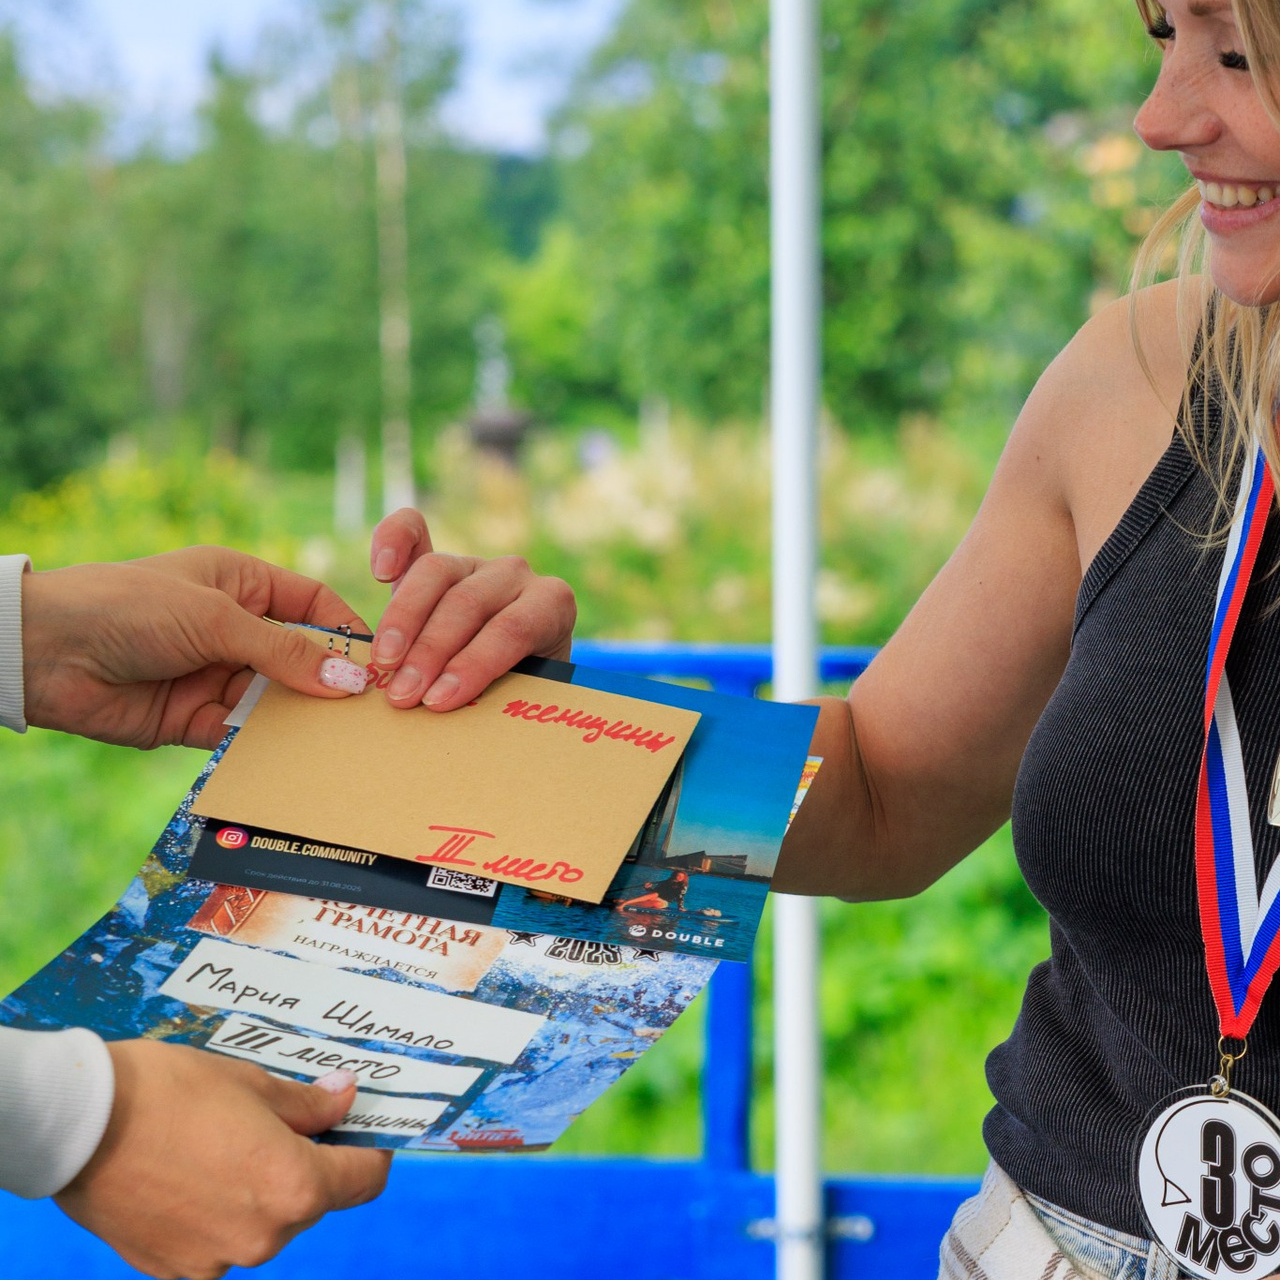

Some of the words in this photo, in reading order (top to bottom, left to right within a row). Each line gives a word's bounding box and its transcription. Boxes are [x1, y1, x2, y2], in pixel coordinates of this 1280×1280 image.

[250, 835, 378, 866] DOUBLE.COMMUNITY
[312, 906, 449, 957] ГРАМОТА
[545, 936, 622, 965] 2025
[651, 929, 726, 947] DOUBLE
[291, 934, 438, 980] НАГРАЖДАЕТСЯ
[1200, 1118, 1237, 1230] 3
